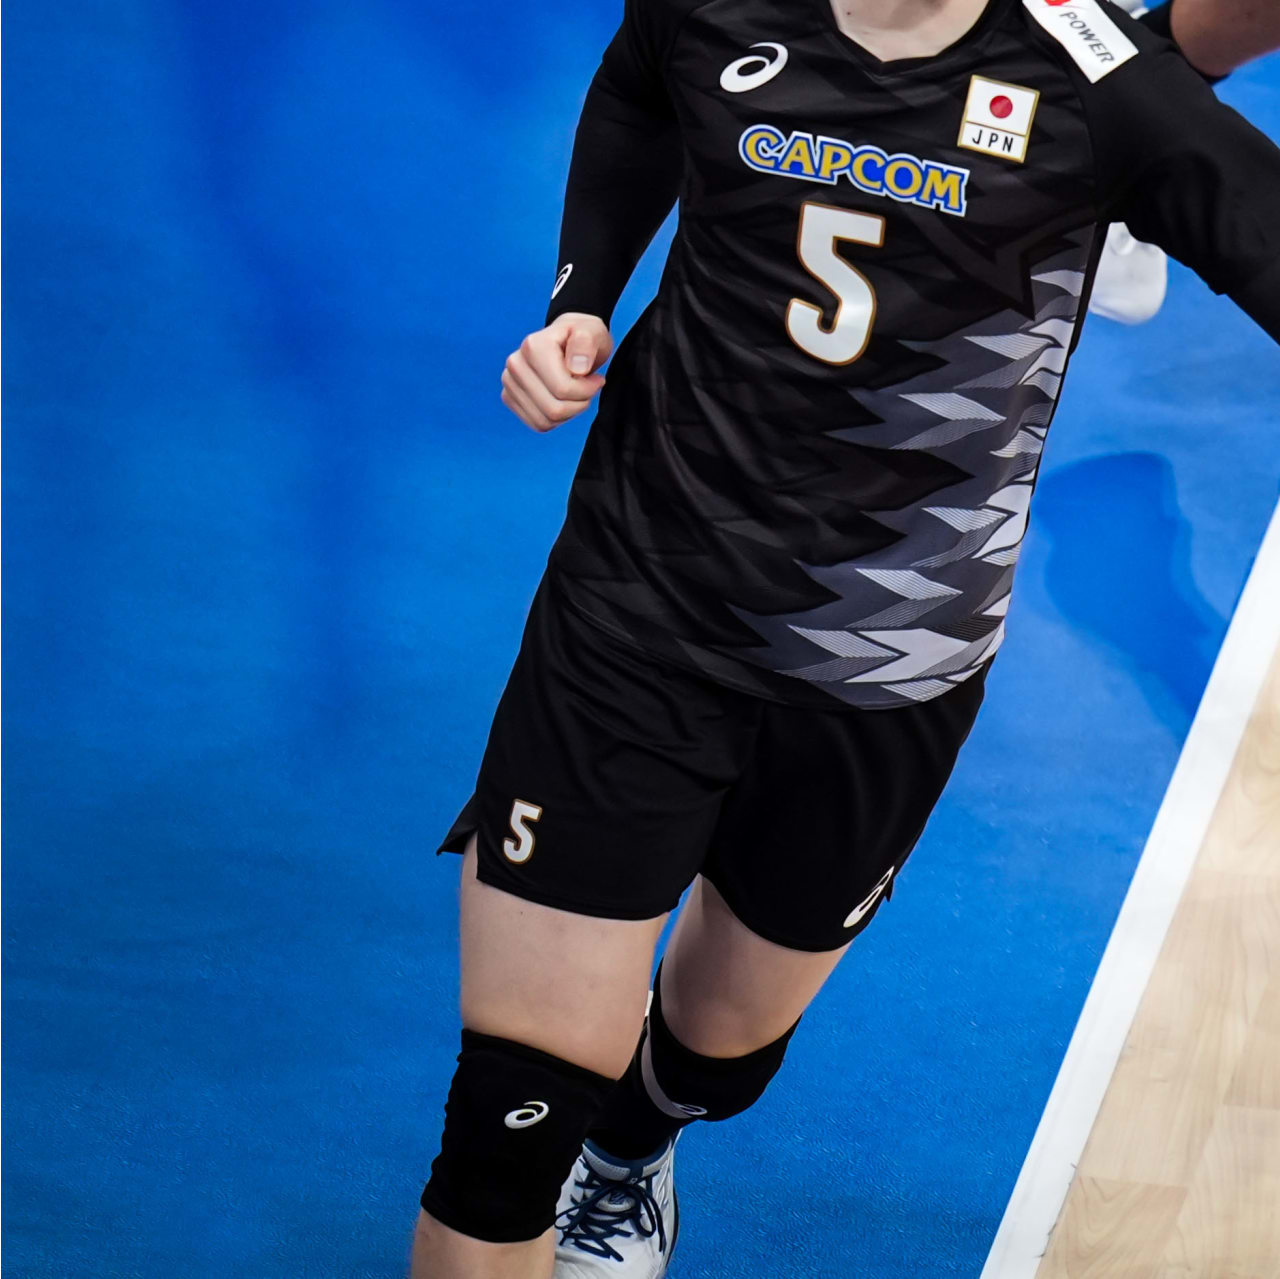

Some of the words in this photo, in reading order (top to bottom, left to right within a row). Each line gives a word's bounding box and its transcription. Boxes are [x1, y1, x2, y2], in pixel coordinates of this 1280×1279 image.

[1060, 11, 1115, 63] POWER
[738, 124, 970, 217] CAPCOM
[972, 129, 1014, 153] JPN
[785, 201, 885, 366] 5
[503, 798, 542, 865] 5
